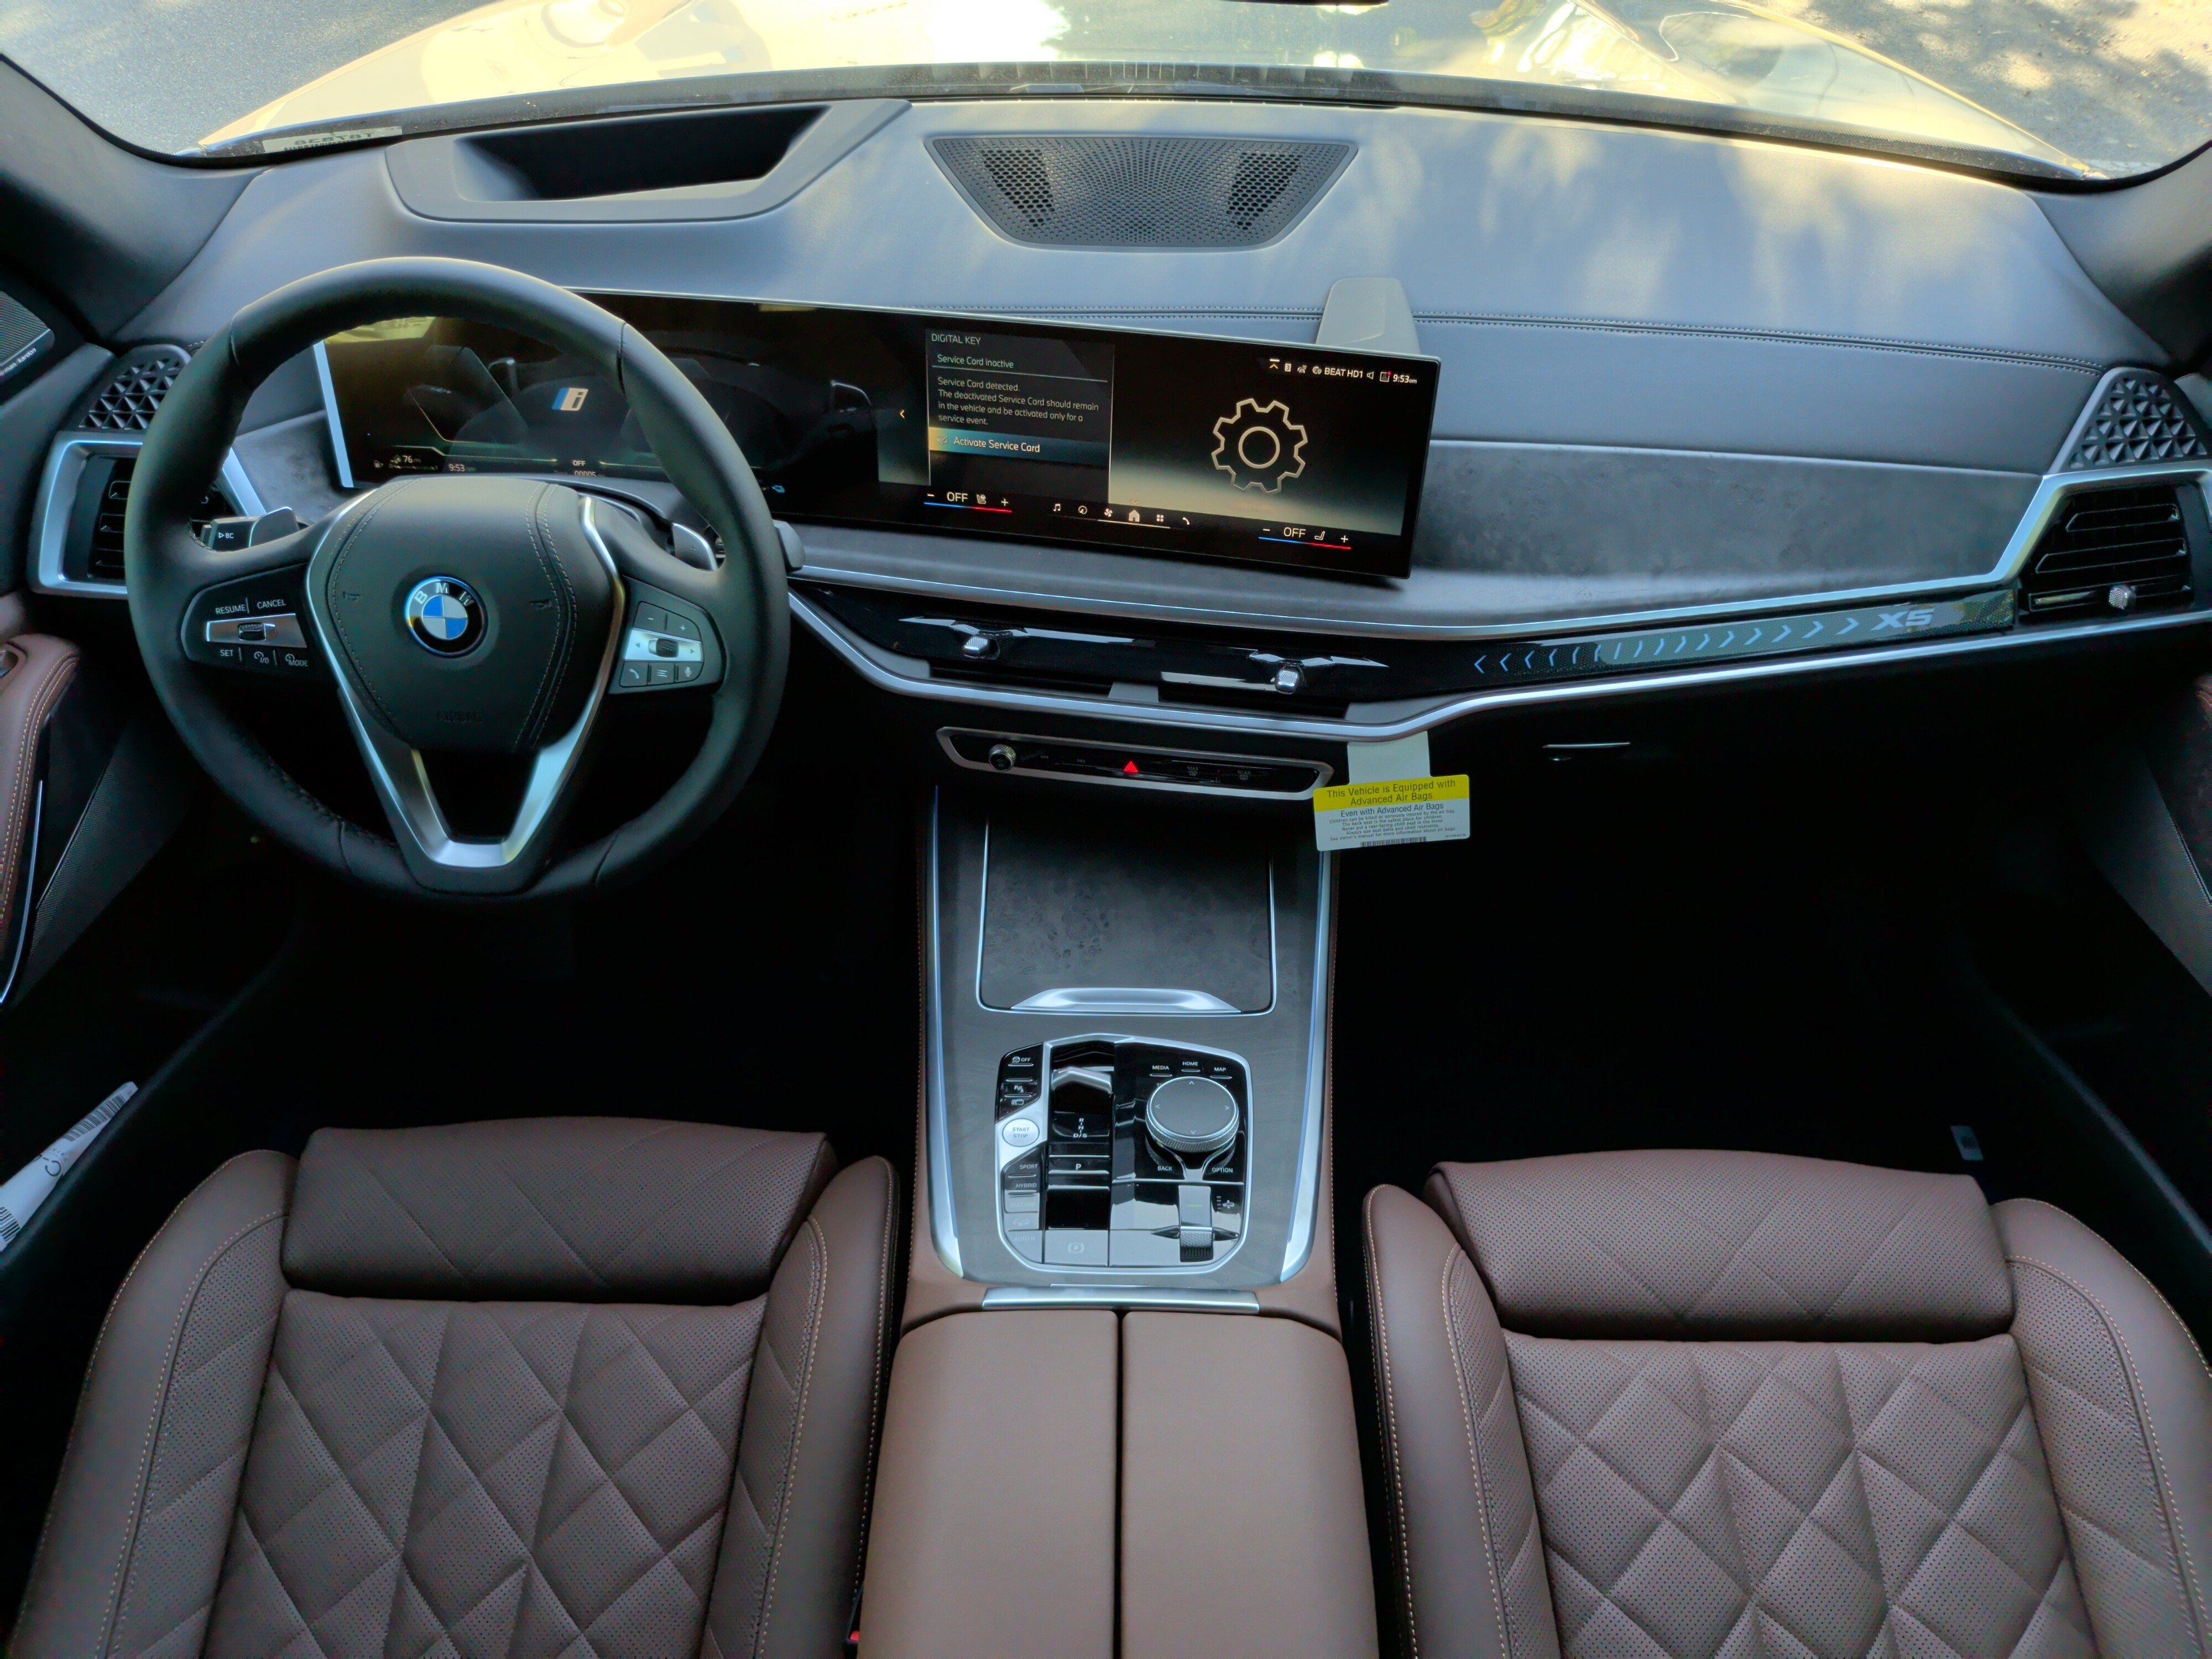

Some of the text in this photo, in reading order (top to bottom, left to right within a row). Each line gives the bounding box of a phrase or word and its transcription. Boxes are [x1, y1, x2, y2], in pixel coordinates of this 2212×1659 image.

[931, 334, 981, 345] DIGITAL KEY
[937, 354, 1014, 368] Service Card inactive
[1324, 368, 1346, 376] BEAT
[1347, 370, 1363, 378] HD1
[938, 377, 965, 387] Service
[985, 382, 1020, 392] detected.
[939, 389, 952, 398] The
[954, 392, 997, 402] deactivated
[999, 395, 1025, 404] Service
[1028, 398, 1045, 406] Card
[1047, 399, 1071, 409] should
[961, 404, 985, 413] vehicle
[1003, 407, 1013, 415] be
[1015, 408, 1047, 419] activated
[1050, 412, 1065, 421] only
[1067, 413, 1077, 421] for
[939, 415, 988, 426] service event.
[954, 437, 1040, 453] Activate Service Card
[947, 492, 968, 503] OFF
[1284, 528, 1306, 538] OFF
[414, 582, 475, 607] BMW
[216, 604, 245, 614] RESUME
[257, 599, 286, 609] CANCEL
[1870, 608, 1934, 632] X5
[1327, 790, 1345, 798] This
[1348, 787, 1379, 796] Vehicle
[1393, 781, 1434, 794] Equipped
[1437, 780, 1455, 788] with
[1350, 796, 1392, 806] Advanced
[1412, 792, 1433, 801] Bags
[1377, 805, 1411, 813] Advanced
